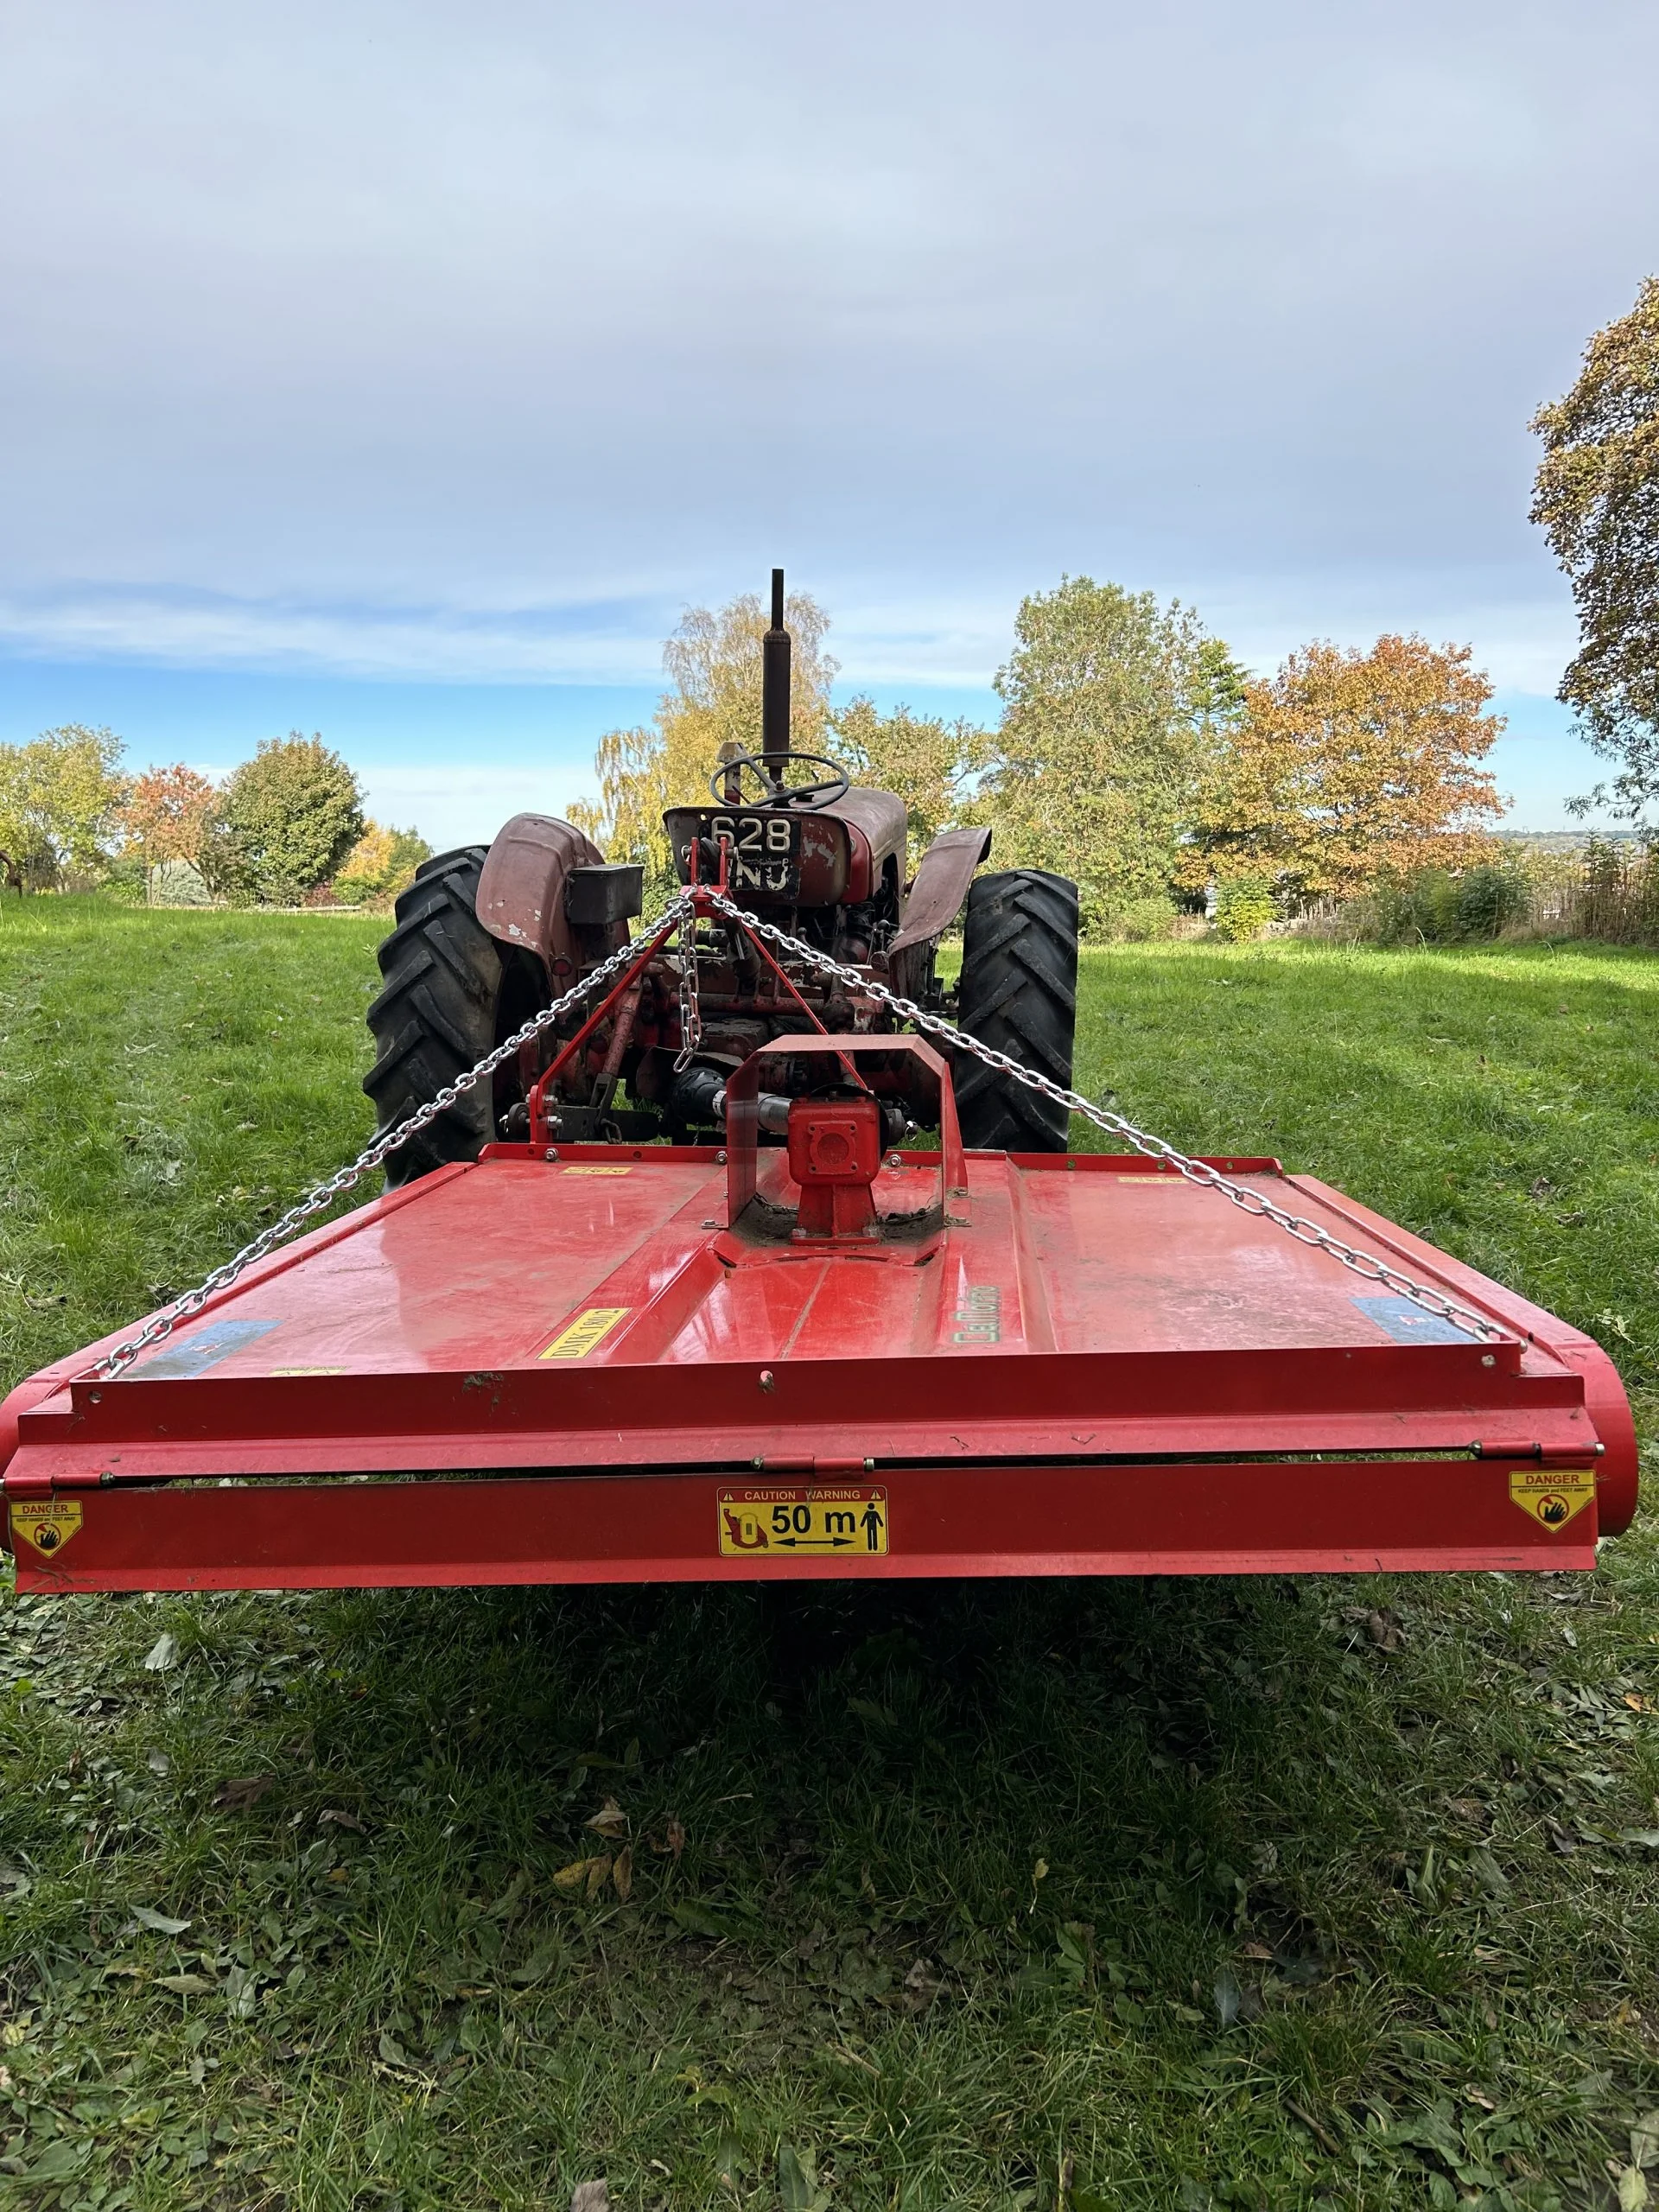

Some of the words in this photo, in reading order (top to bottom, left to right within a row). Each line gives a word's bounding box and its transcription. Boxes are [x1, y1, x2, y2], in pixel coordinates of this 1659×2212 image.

[711, 817, 791, 853] 628
[550, 1332, 599, 1357] DMK
[1526, 1475, 1580, 1484] DANGER
[744, 1491, 796, 1501] CAUTION
[805, 1490, 861, 1500] WARNING
[22, 1505, 68, 1514] DANGER
[771, 1504, 811, 1534] 50
[824, 1510, 856, 1534] m
